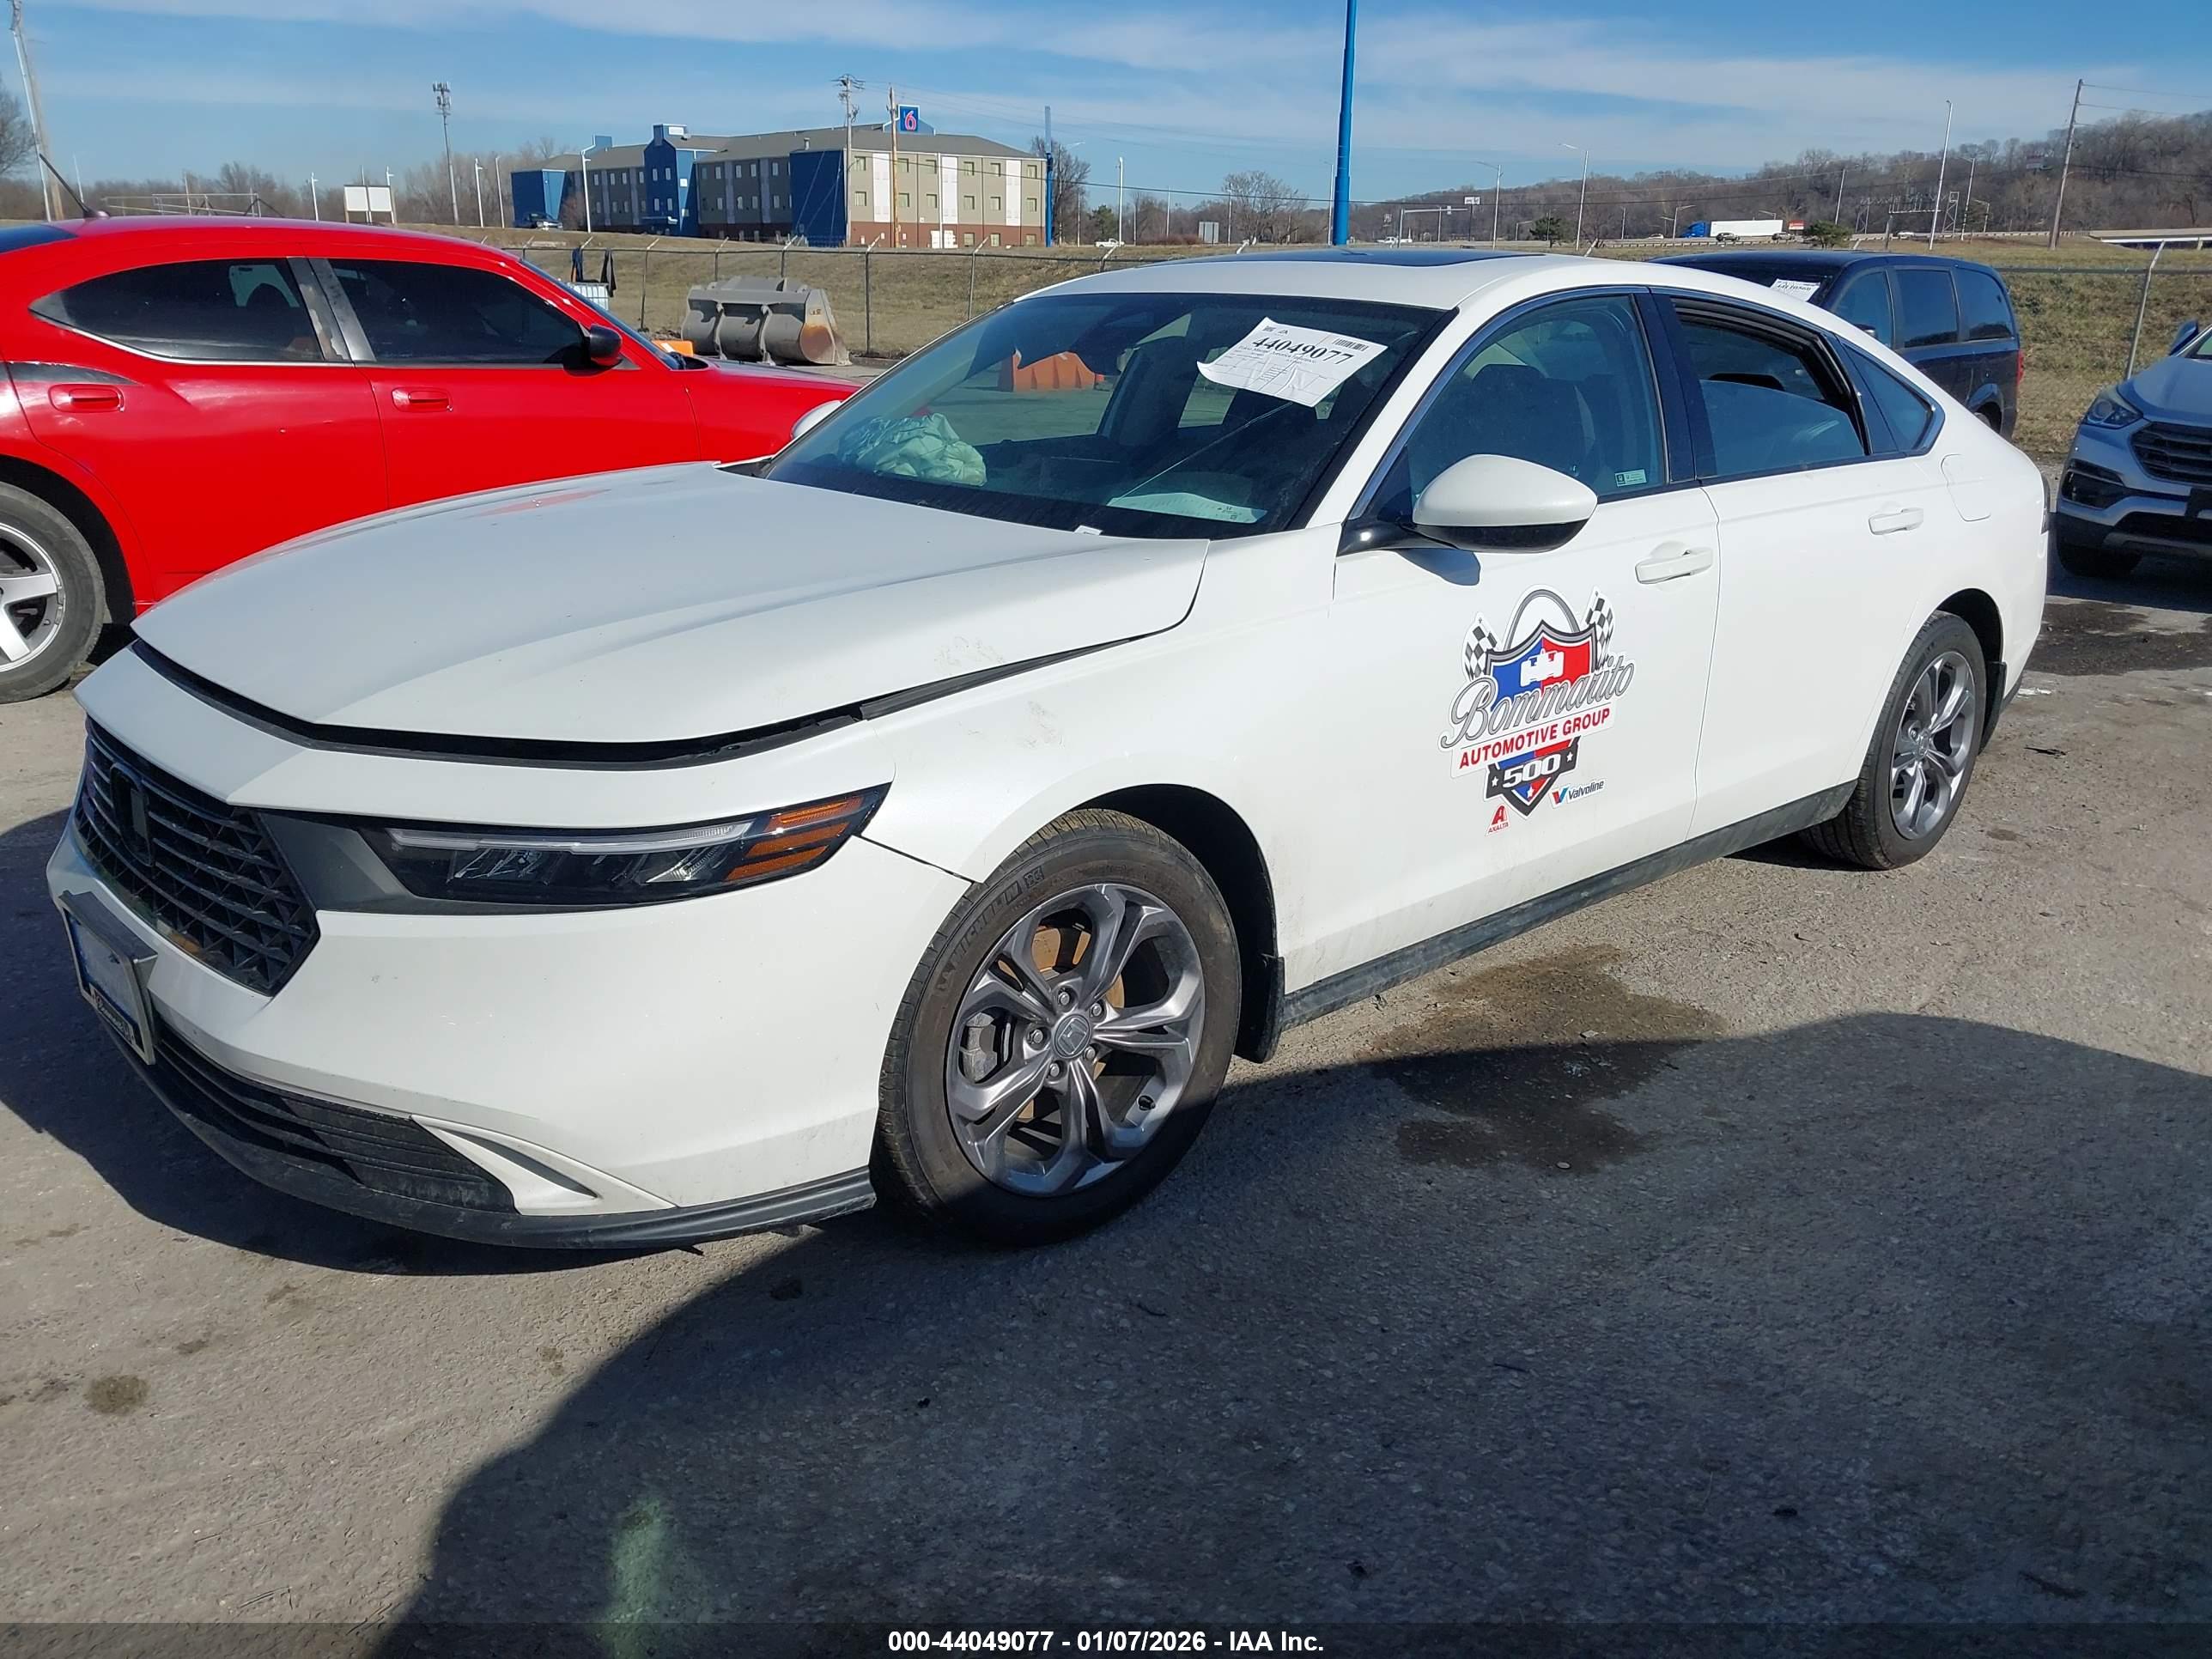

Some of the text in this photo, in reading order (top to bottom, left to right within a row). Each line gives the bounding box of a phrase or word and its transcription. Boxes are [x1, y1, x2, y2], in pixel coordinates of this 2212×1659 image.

[904, 110, 917, 131] 6
[1252, 337, 1354, 365] 44049077
[1440, 655, 1634, 749] Bommarito
[1459, 708, 1610, 769] AUTOMOTIVE GROUP
[1503, 754, 1561, 788] 500
[1569, 781, 1604, 800] Valvoline
